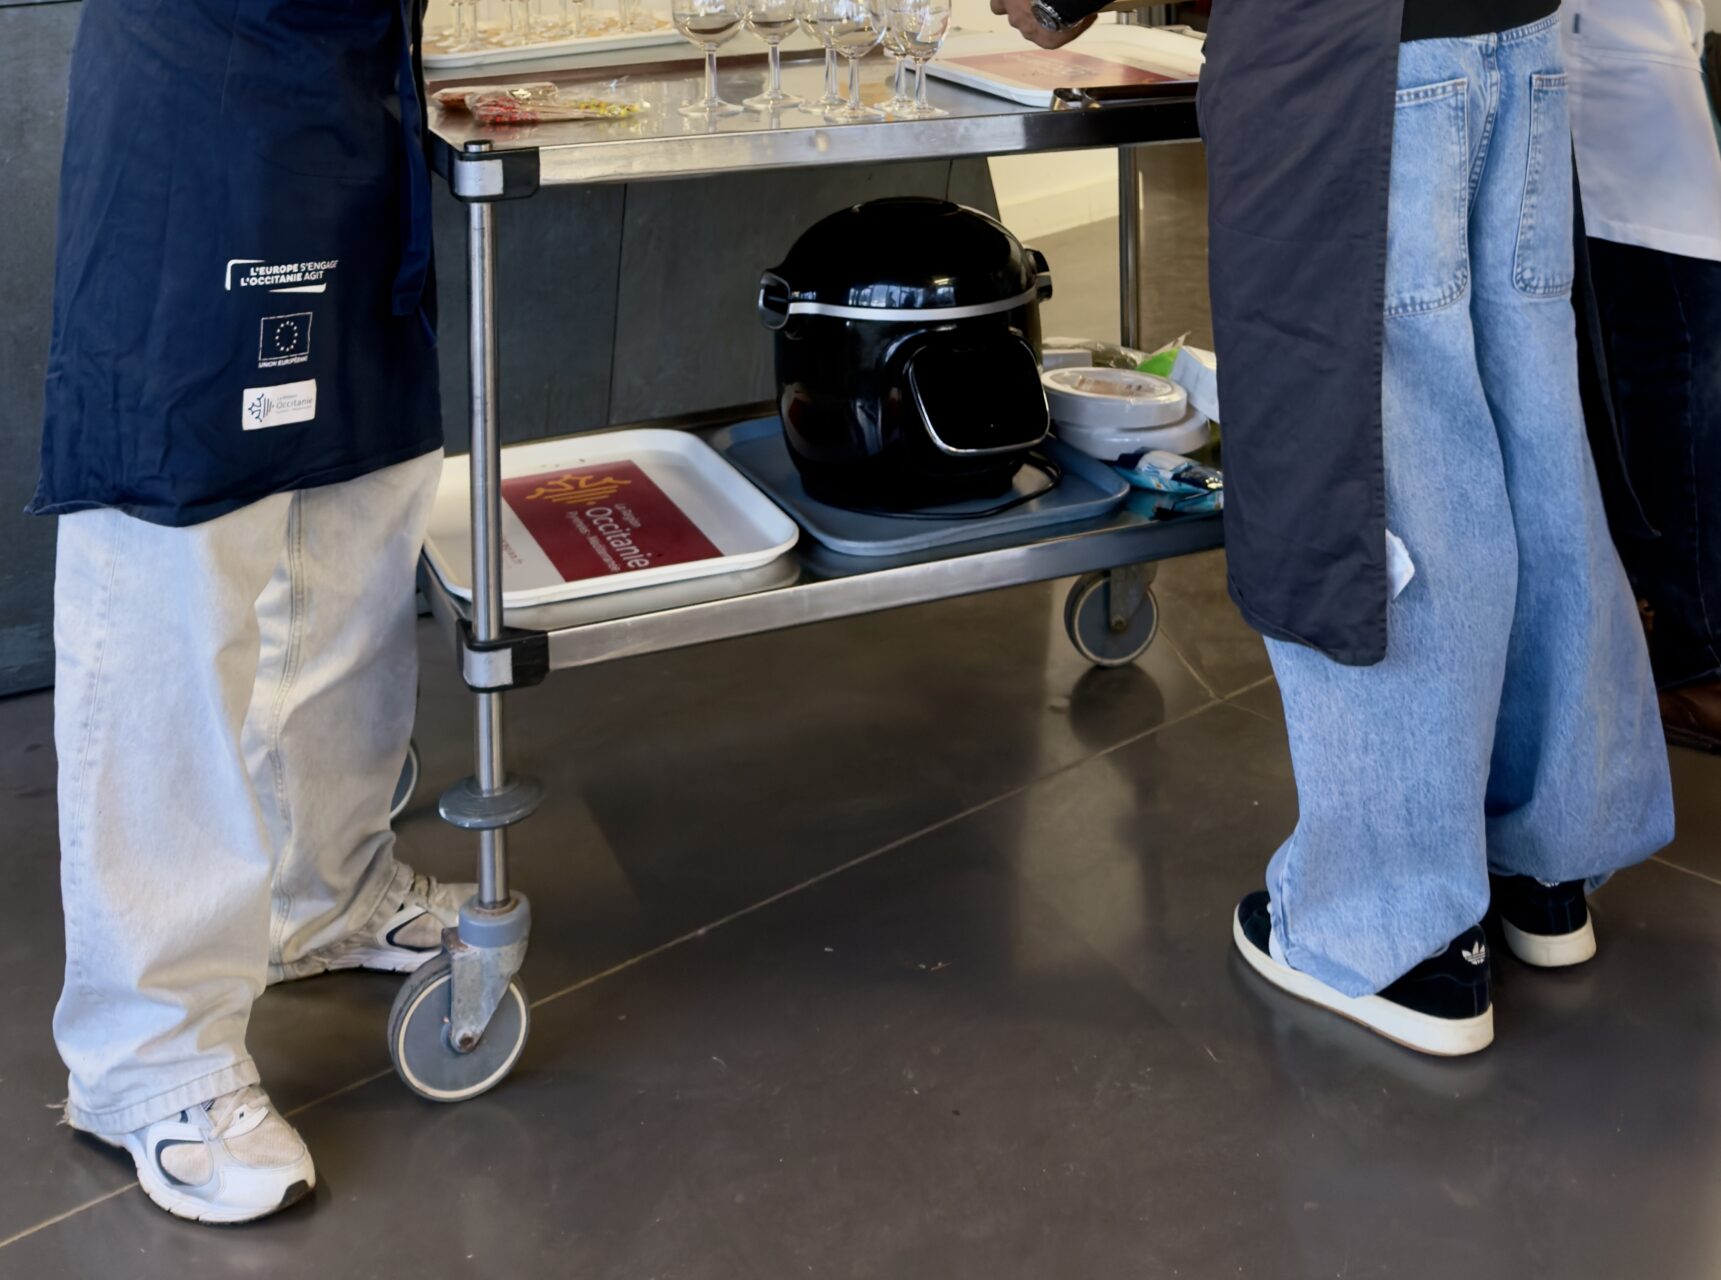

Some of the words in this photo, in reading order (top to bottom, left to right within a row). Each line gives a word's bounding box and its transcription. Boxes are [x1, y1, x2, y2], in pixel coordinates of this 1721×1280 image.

[250, 263, 299, 276] L'EUROPE
[300, 260, 339, 272] S'ENGAGE
[240, 272, 303, 287] L'OCCITANIE
[303, 270, 325, 280] AGIT
[585, 506, 650, 569] Occitanie
